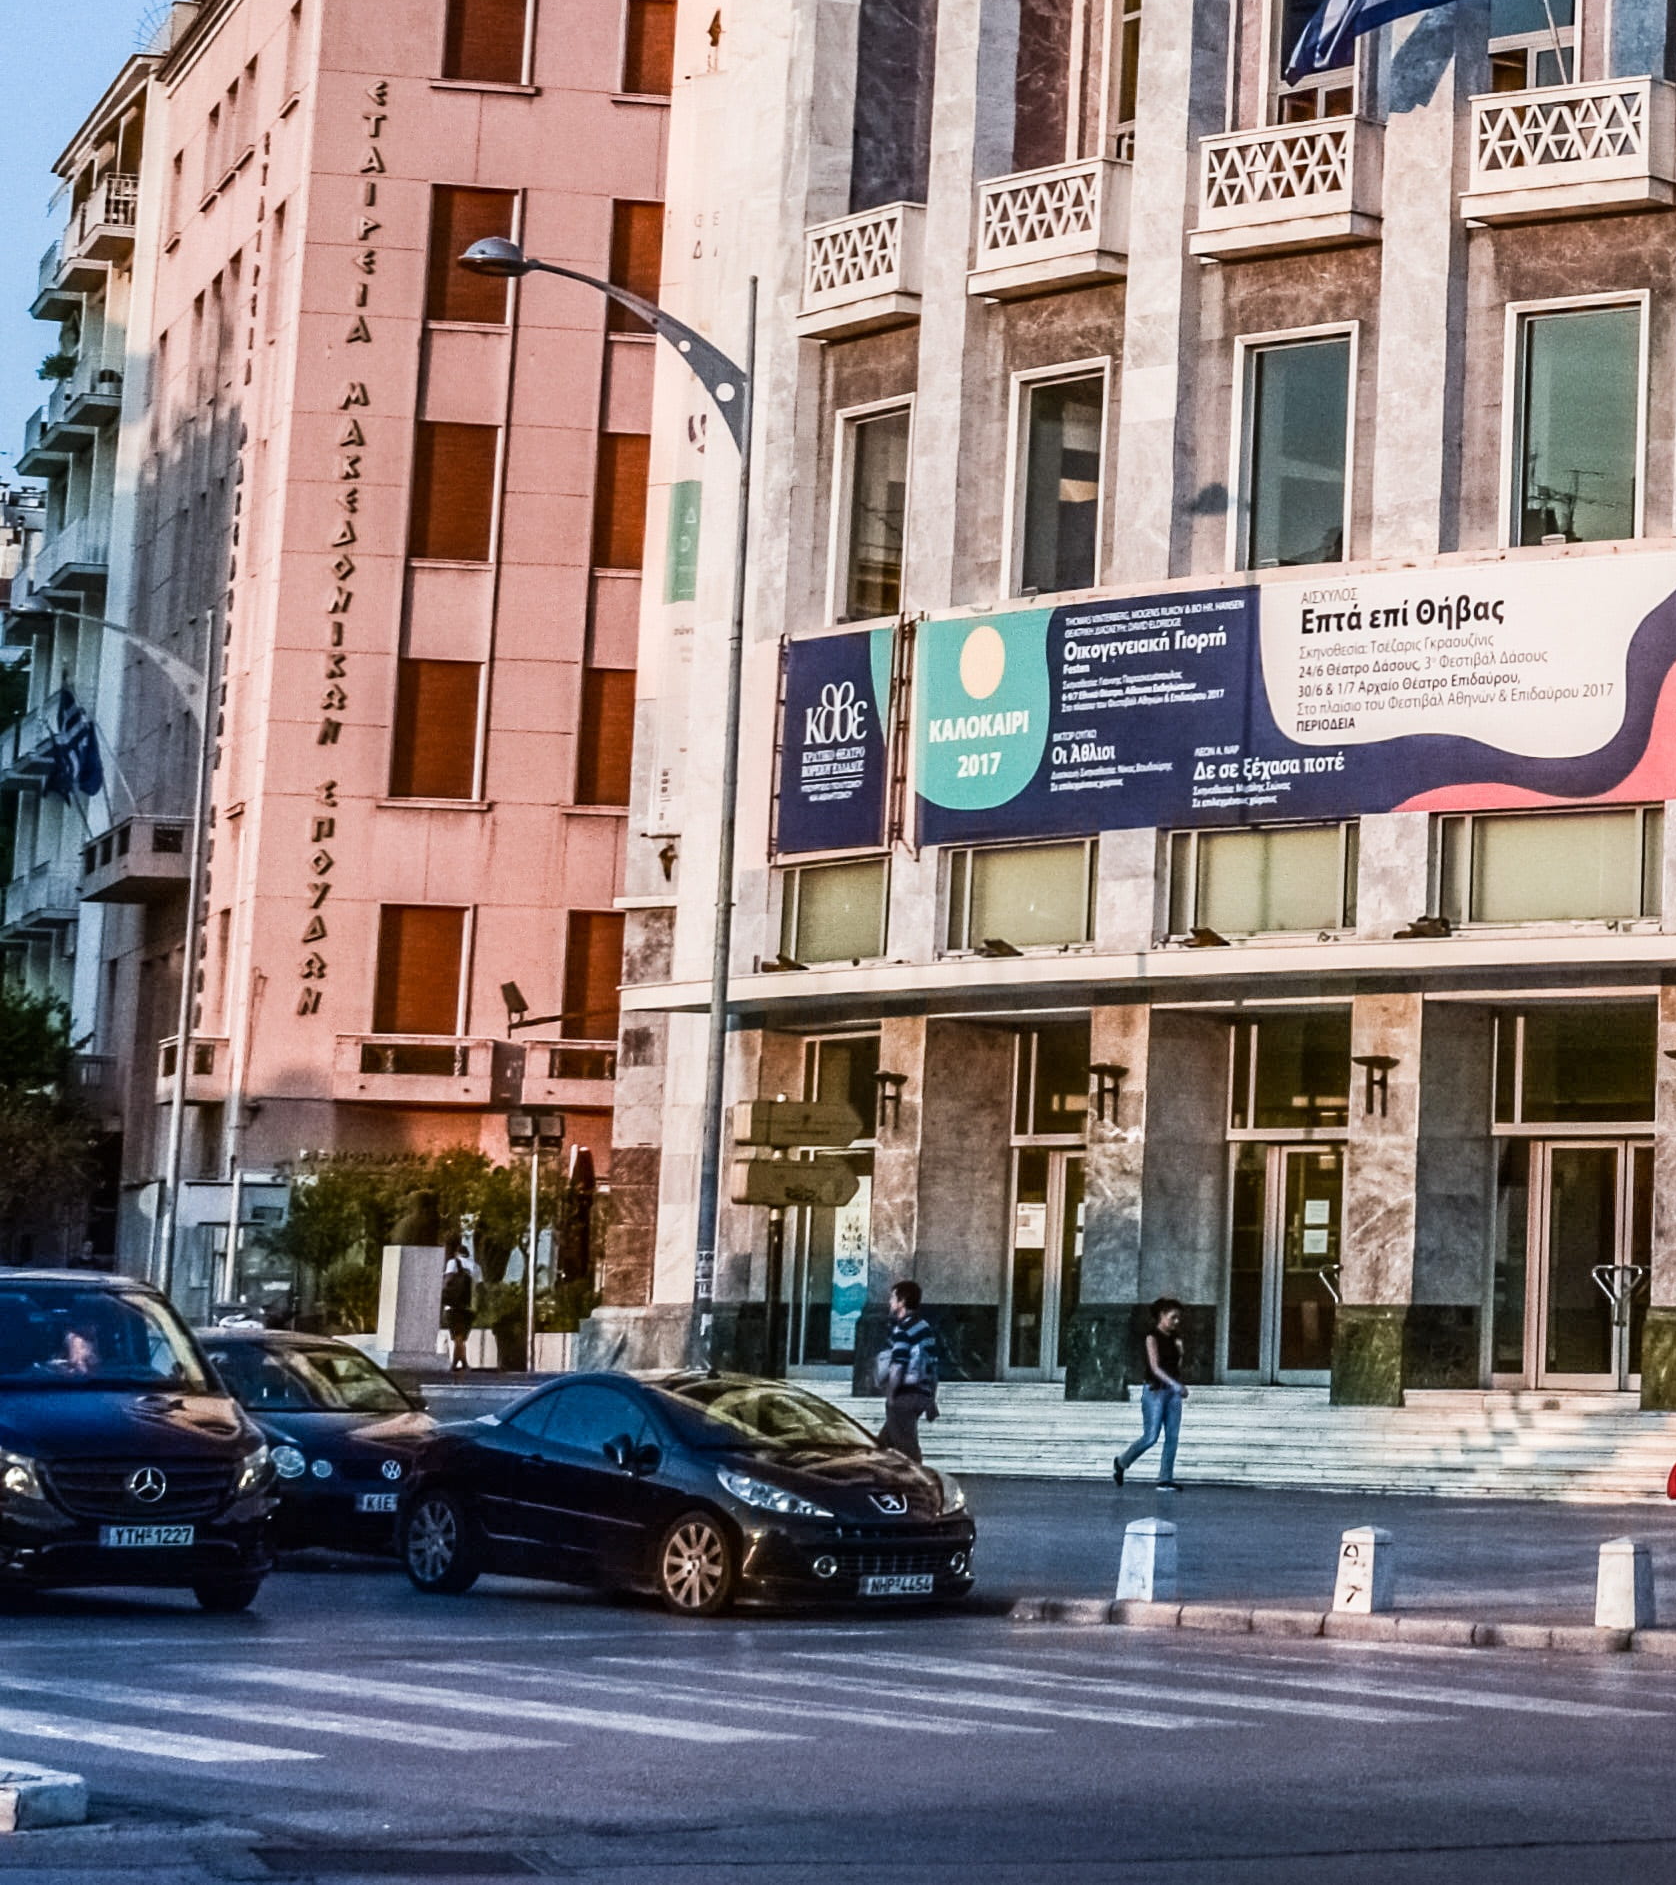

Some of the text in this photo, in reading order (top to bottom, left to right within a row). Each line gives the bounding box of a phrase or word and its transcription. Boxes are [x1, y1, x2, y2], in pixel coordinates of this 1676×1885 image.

[346, 80, 389, 345] ΕΤΑΙΡΕΙΑ
[1301, 588, 1359, 605] ΑΙΣΧΥΛΟΣ
[1301, 594, 1506, 635] Επτά επί Θήβας
[1063, 625, 1227, 663] Οικογενειακή Γιορτή
[1299, 642, 1368, 660] Σκηνοθεσία:
[1298, 665, 1325, 679] 24/6
[1326, 662, 1370, 678] Θέατρο
[1439, 652, 1497, 671] Φεστιβάλ
[1500, 649, 1549, 665] Δάσους
[1297, 683, 1615, 716] Στο πλαίσιο του Φεστιβάλ Αθηνών & Επιδαύρου 2017
[1298, 672, 1522, 699] 30/6 & 1/7 Αρχαίο Θέατρο Επιδαύρου,
[928, 710, 1030, 743] ΚΑΛΟΚΑΙΡΙ
[1296, 717, 1357, 733] ΠΕΡΙΟΔΕΙΑ
[957, 752, 1002, 779] 2017
[1052, 746, 1068, 765] Οι
[1193, 751, 1345, 782] Δε σε ξέχασα ποτέ
